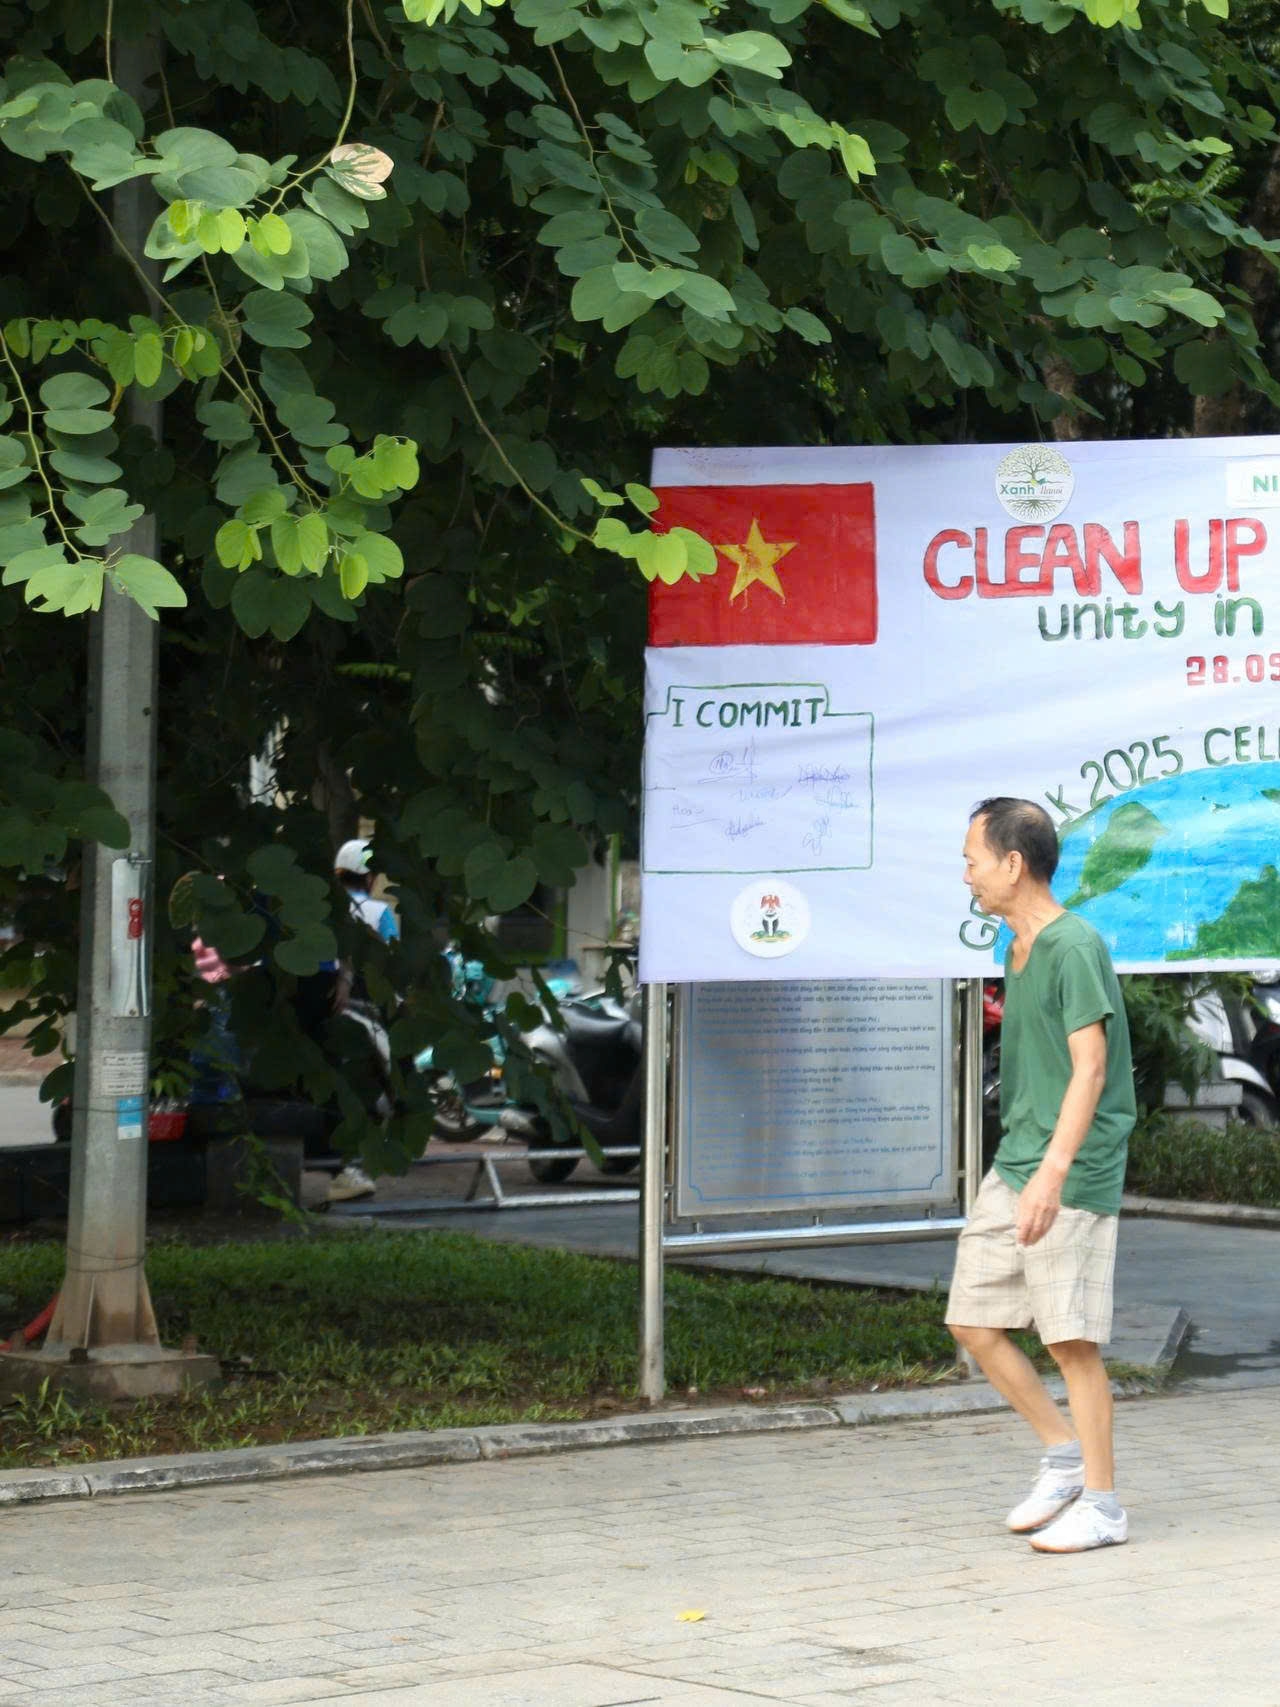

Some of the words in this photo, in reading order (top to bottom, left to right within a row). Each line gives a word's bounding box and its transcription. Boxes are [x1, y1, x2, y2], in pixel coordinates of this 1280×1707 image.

[1000, 484, 1035, 496] Xanh
[923, 519, 1142, 600] CLEAN
[1174, 518, 1267, 594] UP
[1214, 593, 1265, 637] in
[671, 699, 684, 726] I
[696, 698, 826, 728] COMMIT
[1080, 735, 1185, 809] 2025
